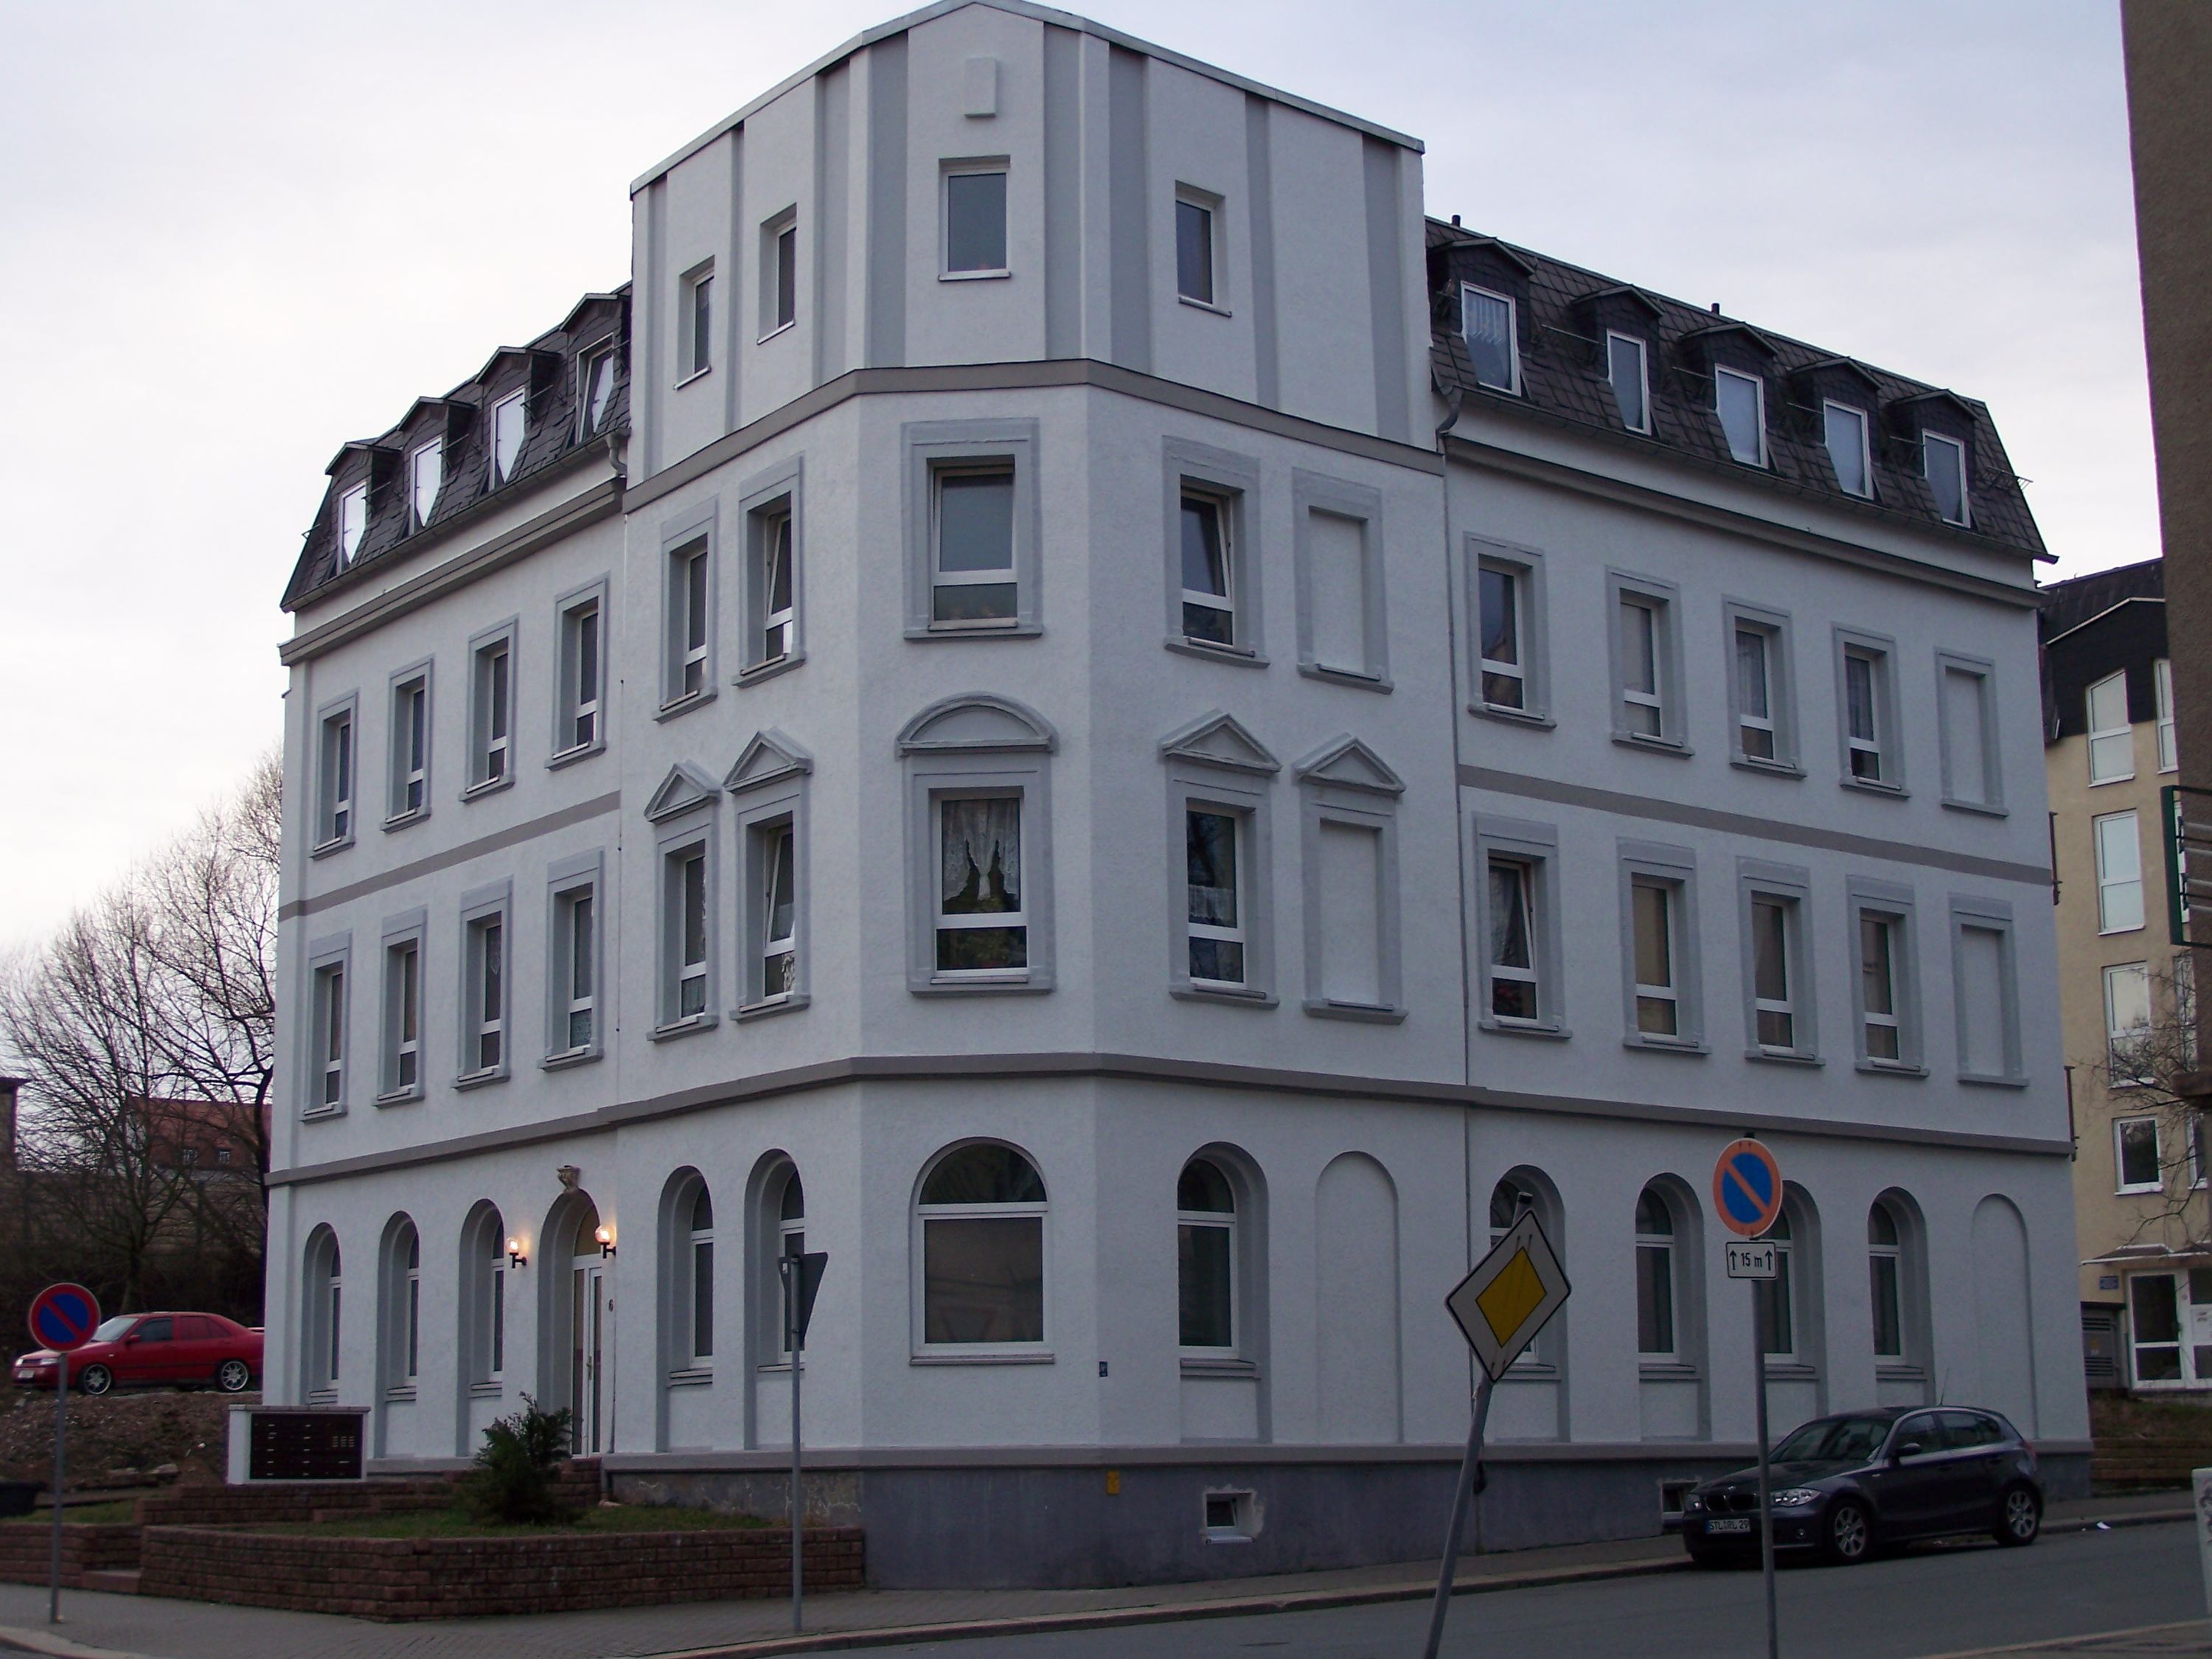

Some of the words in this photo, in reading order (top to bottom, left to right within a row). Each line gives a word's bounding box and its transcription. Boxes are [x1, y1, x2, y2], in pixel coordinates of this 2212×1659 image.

[1741, 1252, 1750, 1267] 15
[1754, 1256, 1763, 1267] m
[608, 1298, 614, 1312] 6
